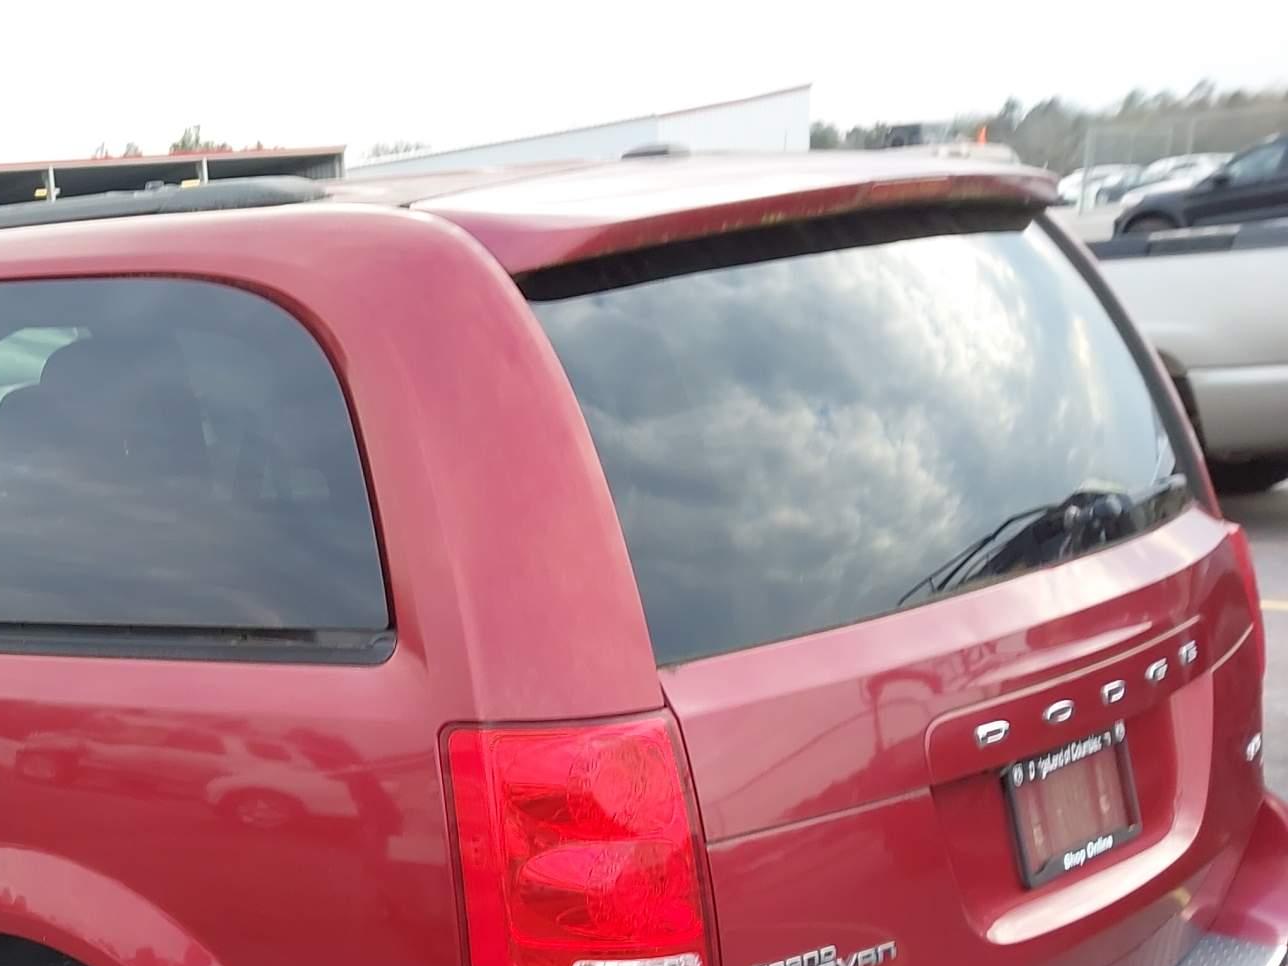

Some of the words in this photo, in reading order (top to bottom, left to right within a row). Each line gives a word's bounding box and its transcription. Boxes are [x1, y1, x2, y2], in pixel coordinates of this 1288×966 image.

[974, 640, 1198, 745] DODGE
[1063, 848, 1086, 871] Shop
[1086, 835, 1114, 858] Online
